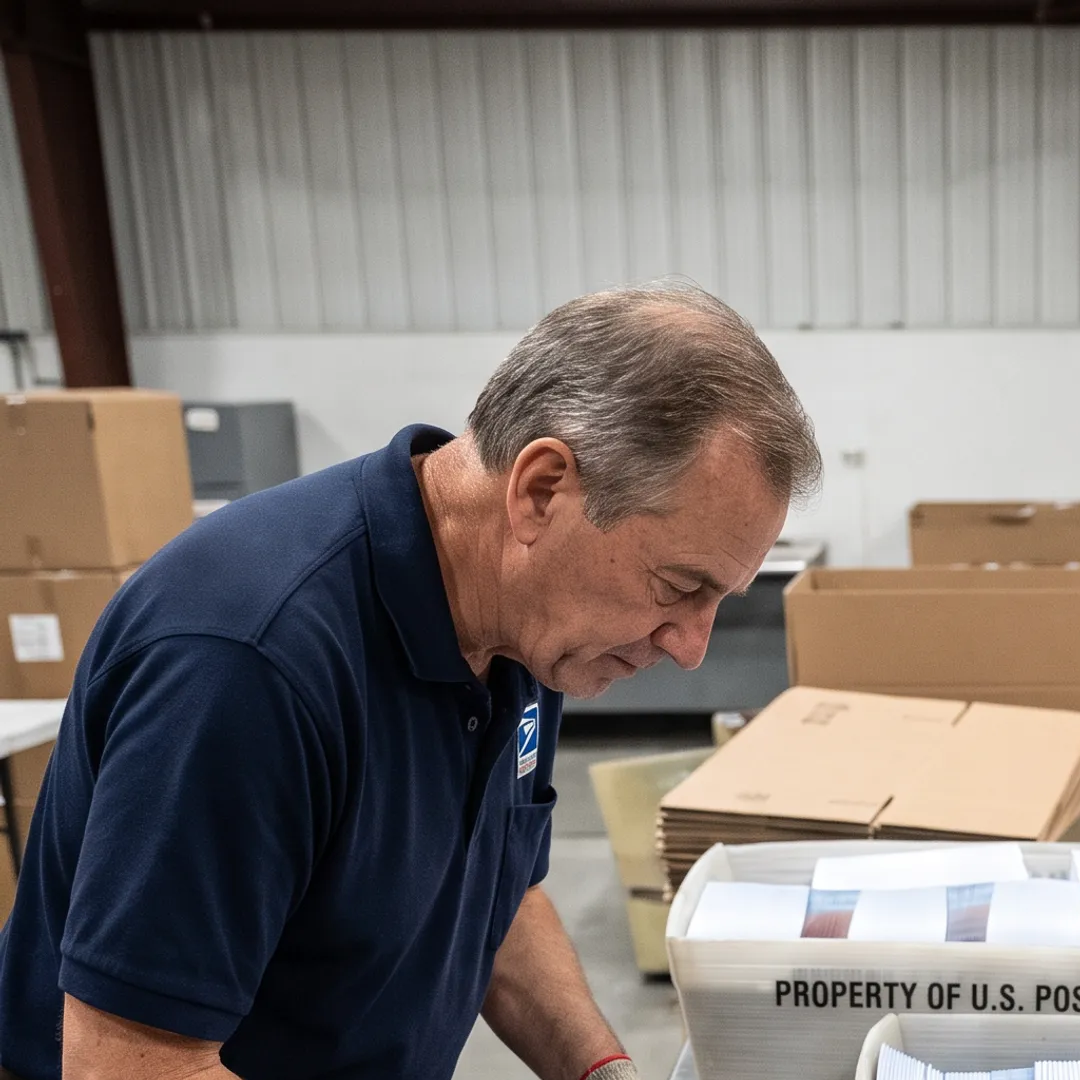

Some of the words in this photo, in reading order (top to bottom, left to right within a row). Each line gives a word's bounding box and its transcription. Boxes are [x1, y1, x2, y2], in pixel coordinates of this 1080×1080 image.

[775, 980, 917, 1009] PROPERTY
[927, 983, 961, 1010] OF
[971, 984, 1024, 1012] U.S.
